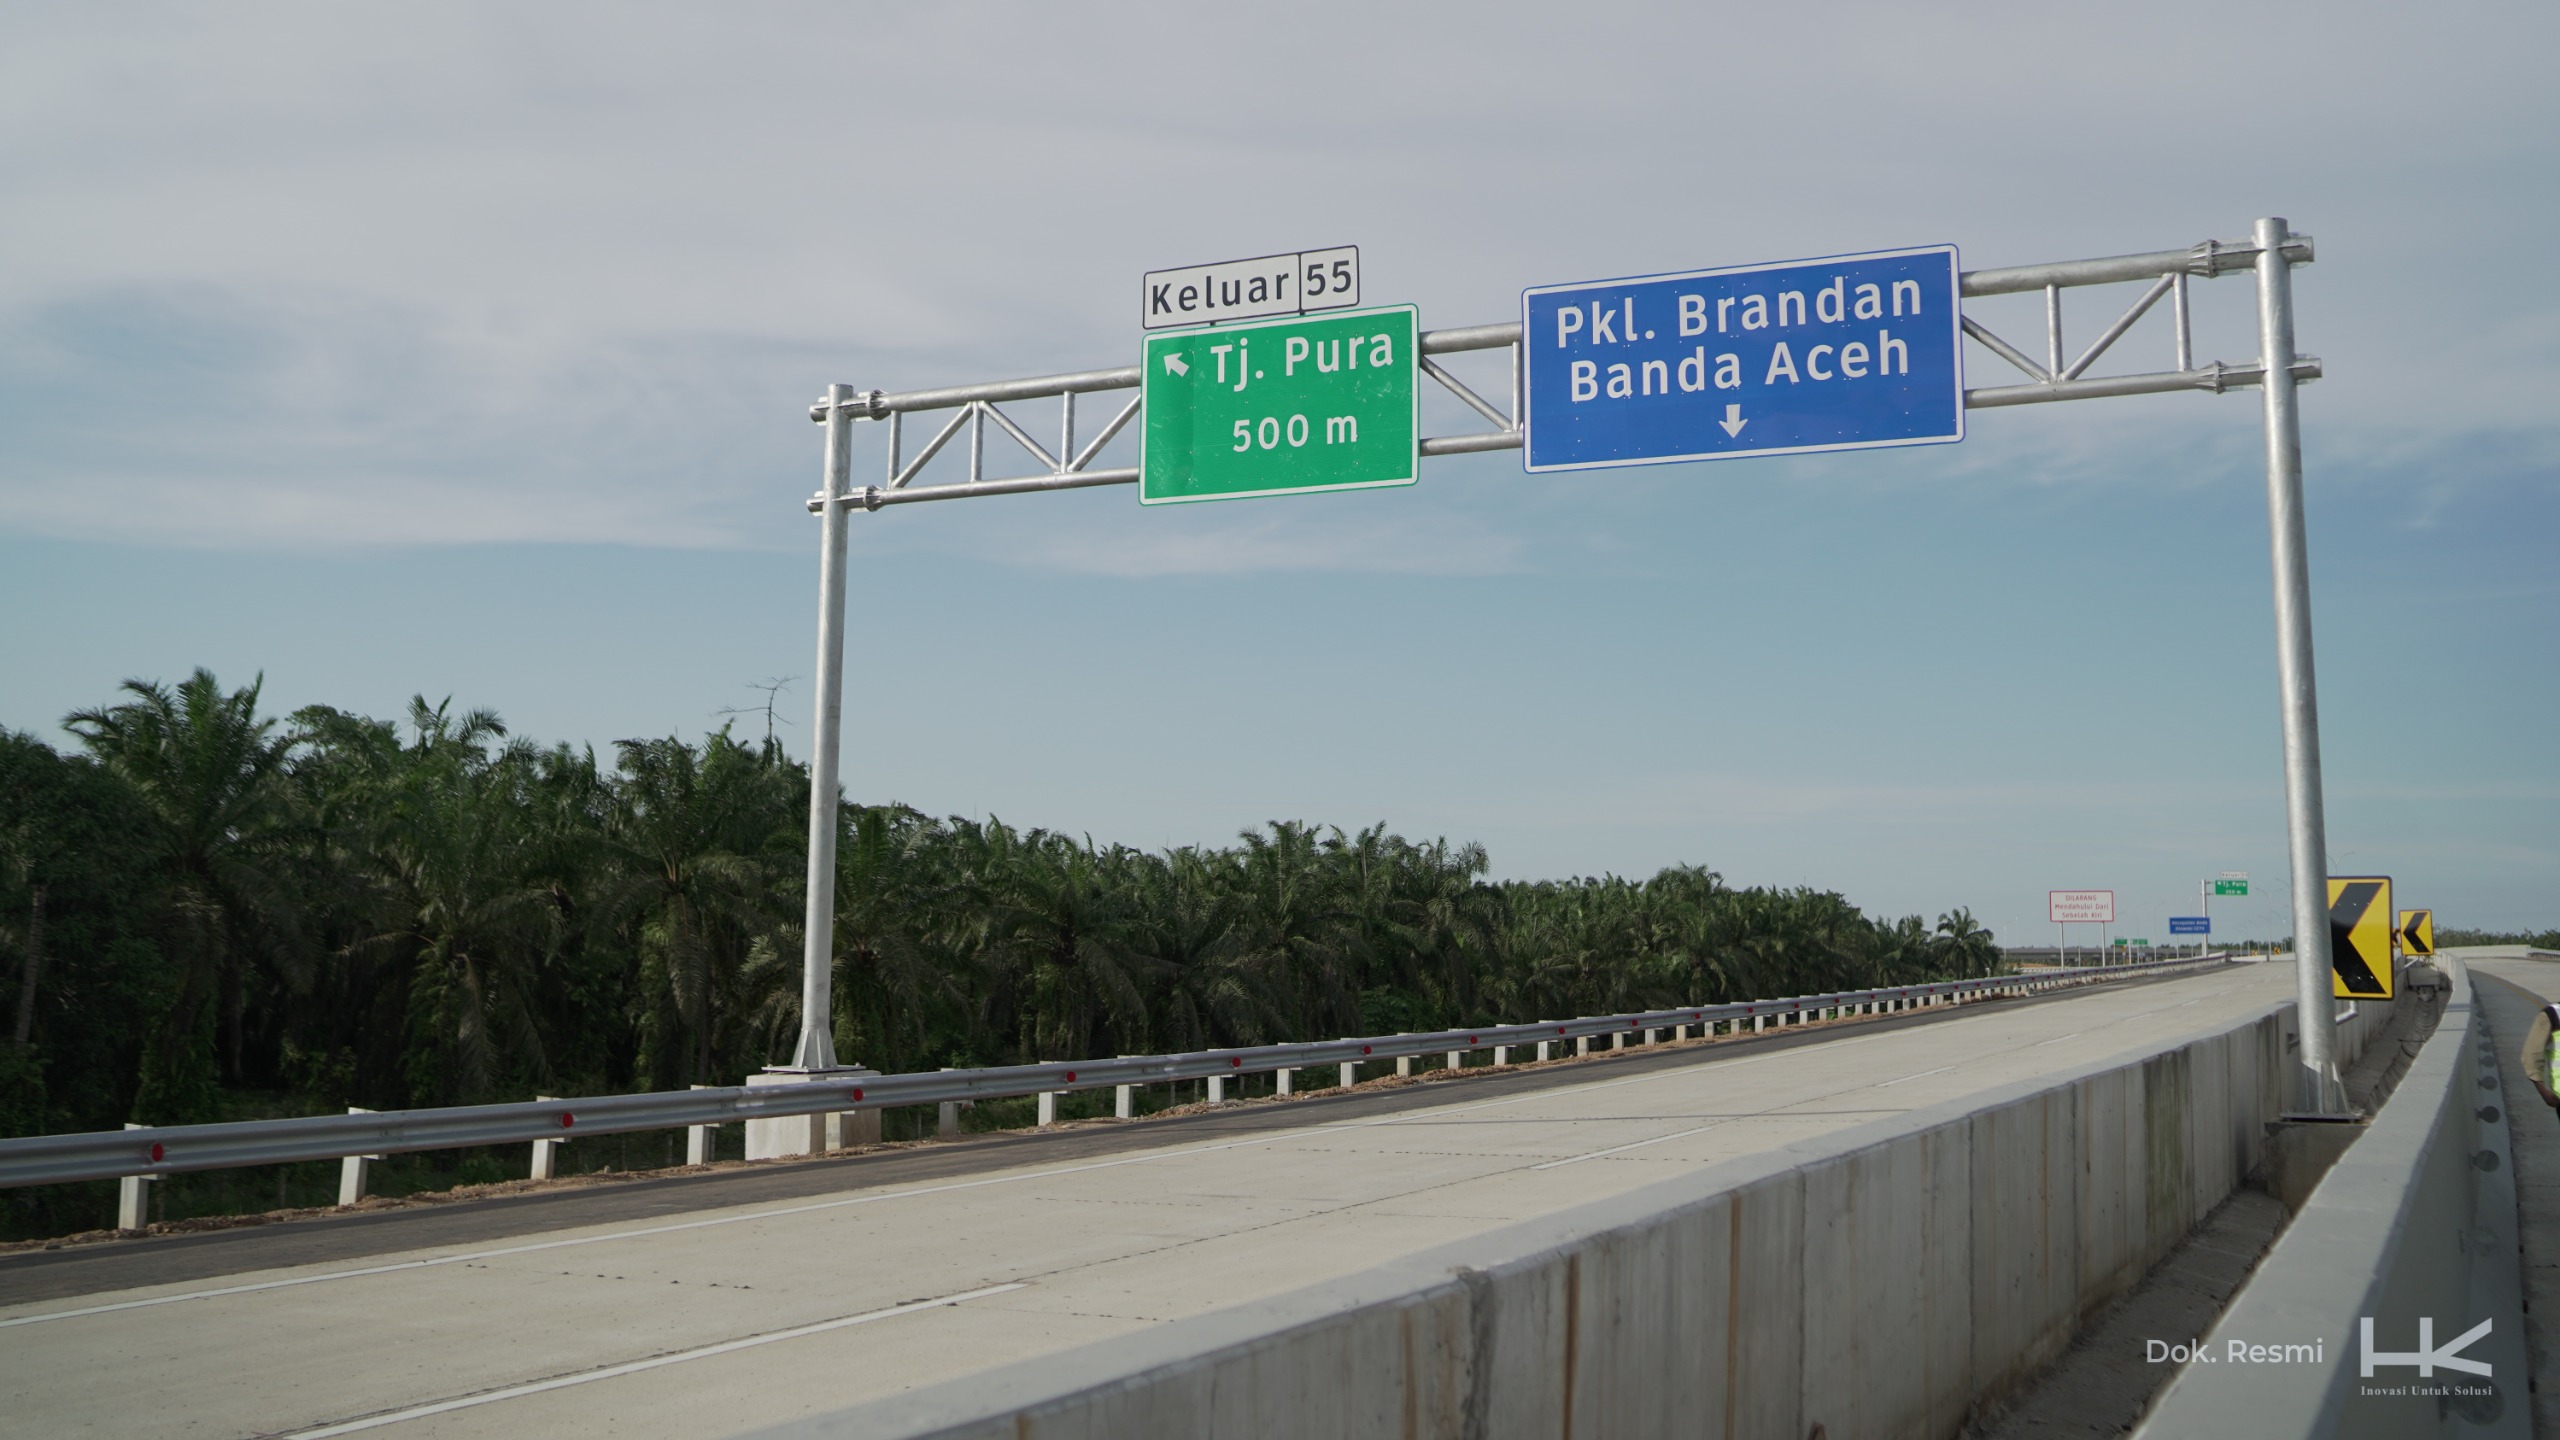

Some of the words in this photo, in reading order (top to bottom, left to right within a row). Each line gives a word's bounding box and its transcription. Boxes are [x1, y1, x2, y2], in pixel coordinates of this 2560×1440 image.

[1153, 273, 1290, 315] Keluar
[1306, 261, 1352, 296] 55
[1557, 298, 1655, 349] Pkl.
[1678, 277, 1921, 337] Brandan
[1210, 338, 1264, 392] Tj.
[1285, 334, 1394, 377] Pura
[1570, 346, 1742, 404] Banda
[1764, 330, 1908, 385] Aceh
[1233, 413, 1309, 453] 500
[1326, 415, 1358, 445] m
